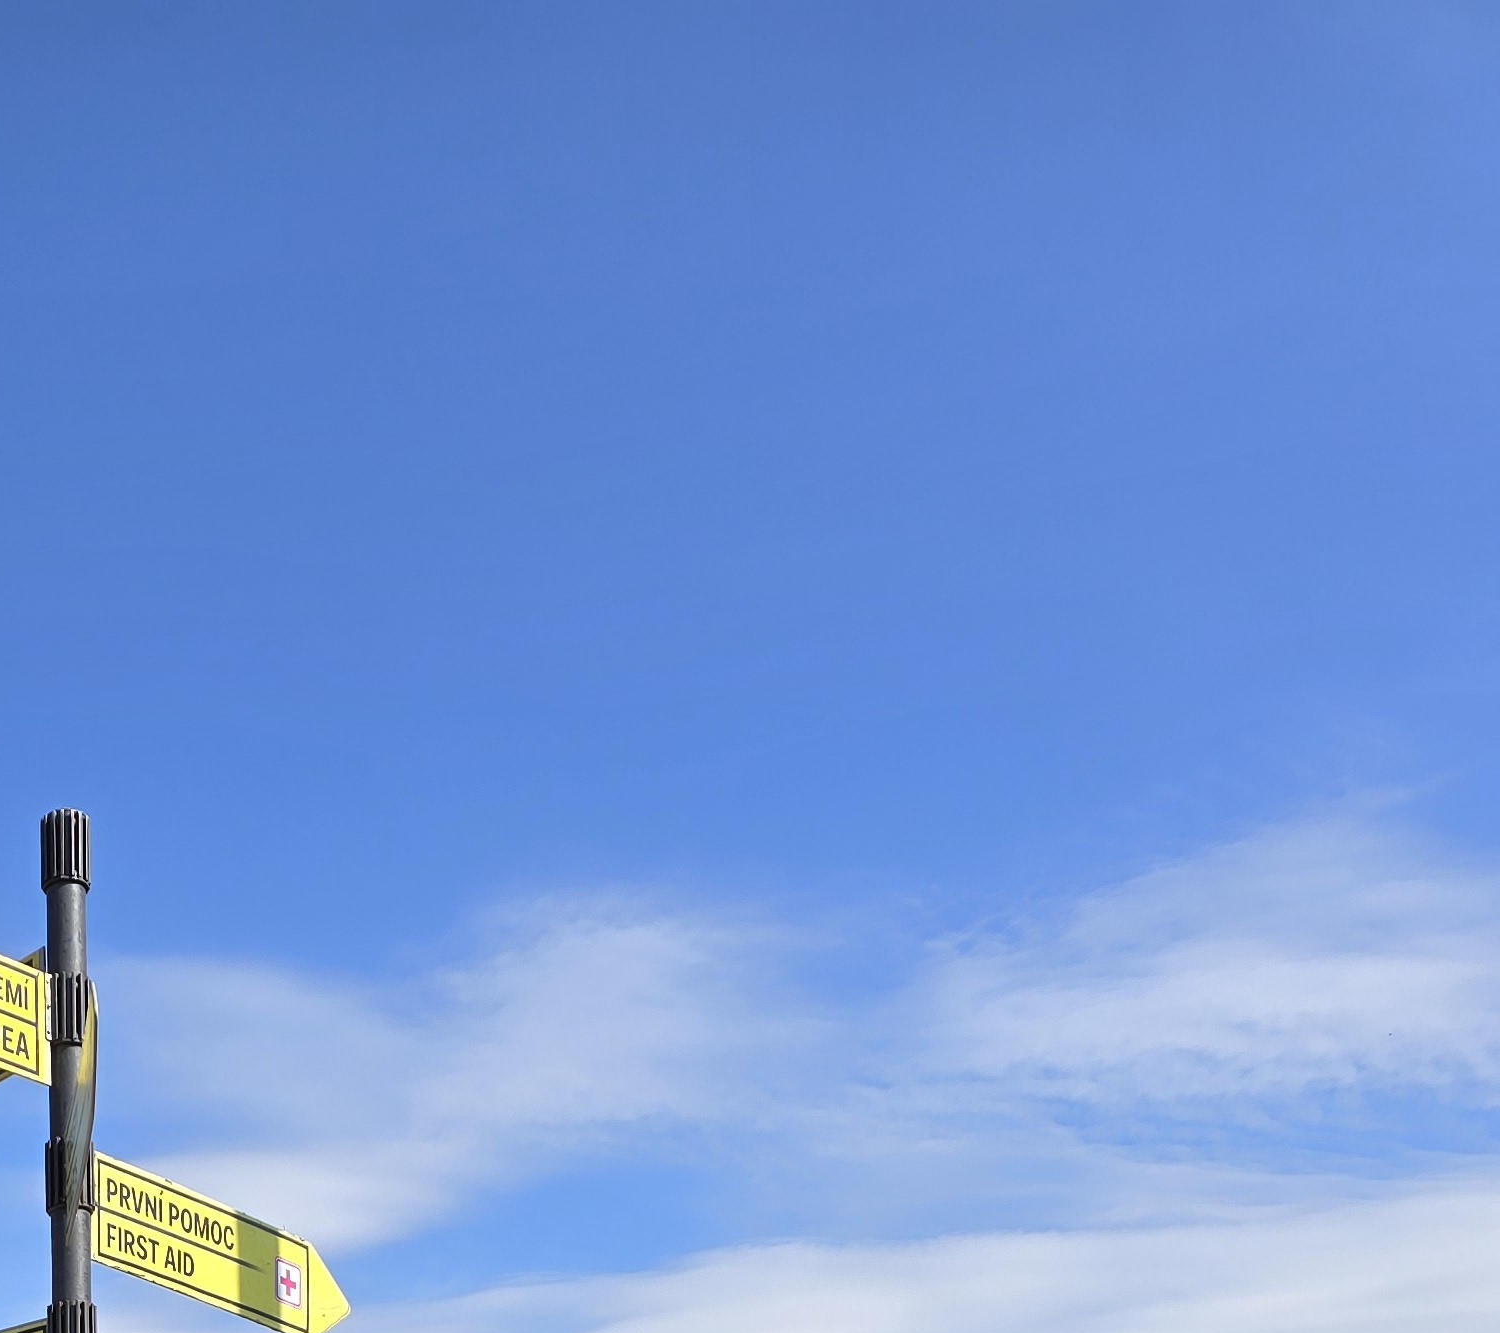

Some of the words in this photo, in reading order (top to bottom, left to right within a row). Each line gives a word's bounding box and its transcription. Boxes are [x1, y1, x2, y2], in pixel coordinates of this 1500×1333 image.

[106, 1177, 164, 1224] PRVNÍ
[168, 1203, 236, 1252] POMOC
[106, 1222, 160, 1267] FIRST
[163, 1243, 196, 1278] AID
